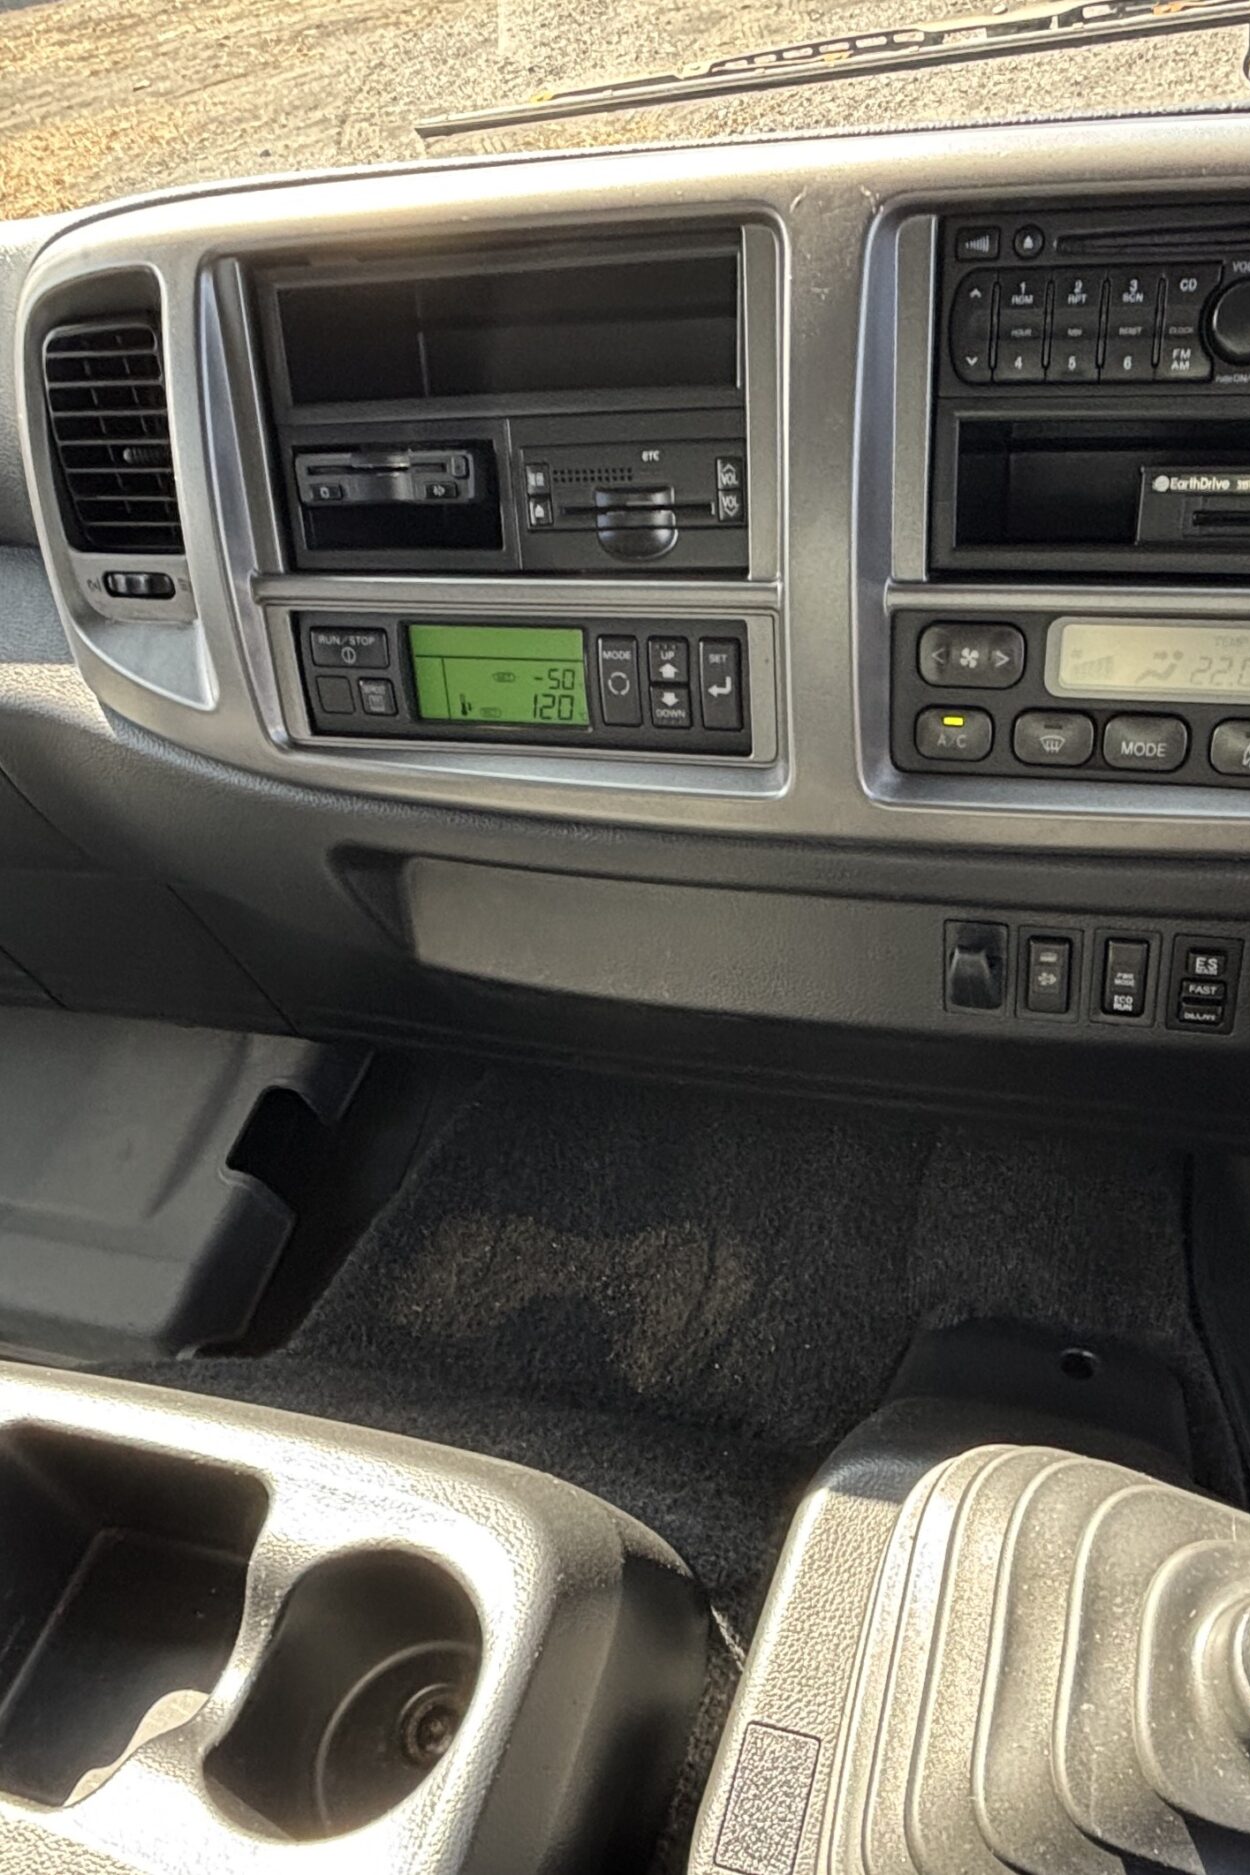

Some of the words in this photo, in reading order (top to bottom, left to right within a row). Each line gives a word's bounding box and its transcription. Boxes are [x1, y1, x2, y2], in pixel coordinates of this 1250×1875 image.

[1020, 281, 1026, 294] 1
[1074, 281, 1083, 293] 2
[1130, 279, 1139, 292] 3
[1179, 278, 1198, 292] CD
[1172, 349, 1192, 360] FM
[1014, 357, 1023, 370] 4
[1068, 356, 1077, 370] 5
[1123, 356, 1133, 370] 6
[1171, 361, 1191, 371] AM
[721, 473, 738, 485] VOL
[1170, 476, 1230, 491] EarthDrive
[722, 496, 739, 507] VOL
[318, 634, 375, 646] RUN/STOP
[603, 650, 631, 660] MODE
[660, 651, 675, 661] UP
[709, 653, 728, 664] SET
[534, 668, 575, 690] -50
[533, 694, 574, 720] 120
[656, 708, 686, 718] DOWN
[1121, 741, 1167, 757] MODE
[1189, 985, 1217, 995] FAST
[1113, 994, 1133, 1003] ECO
[1113, 1003, 1132, 1011] RUN
